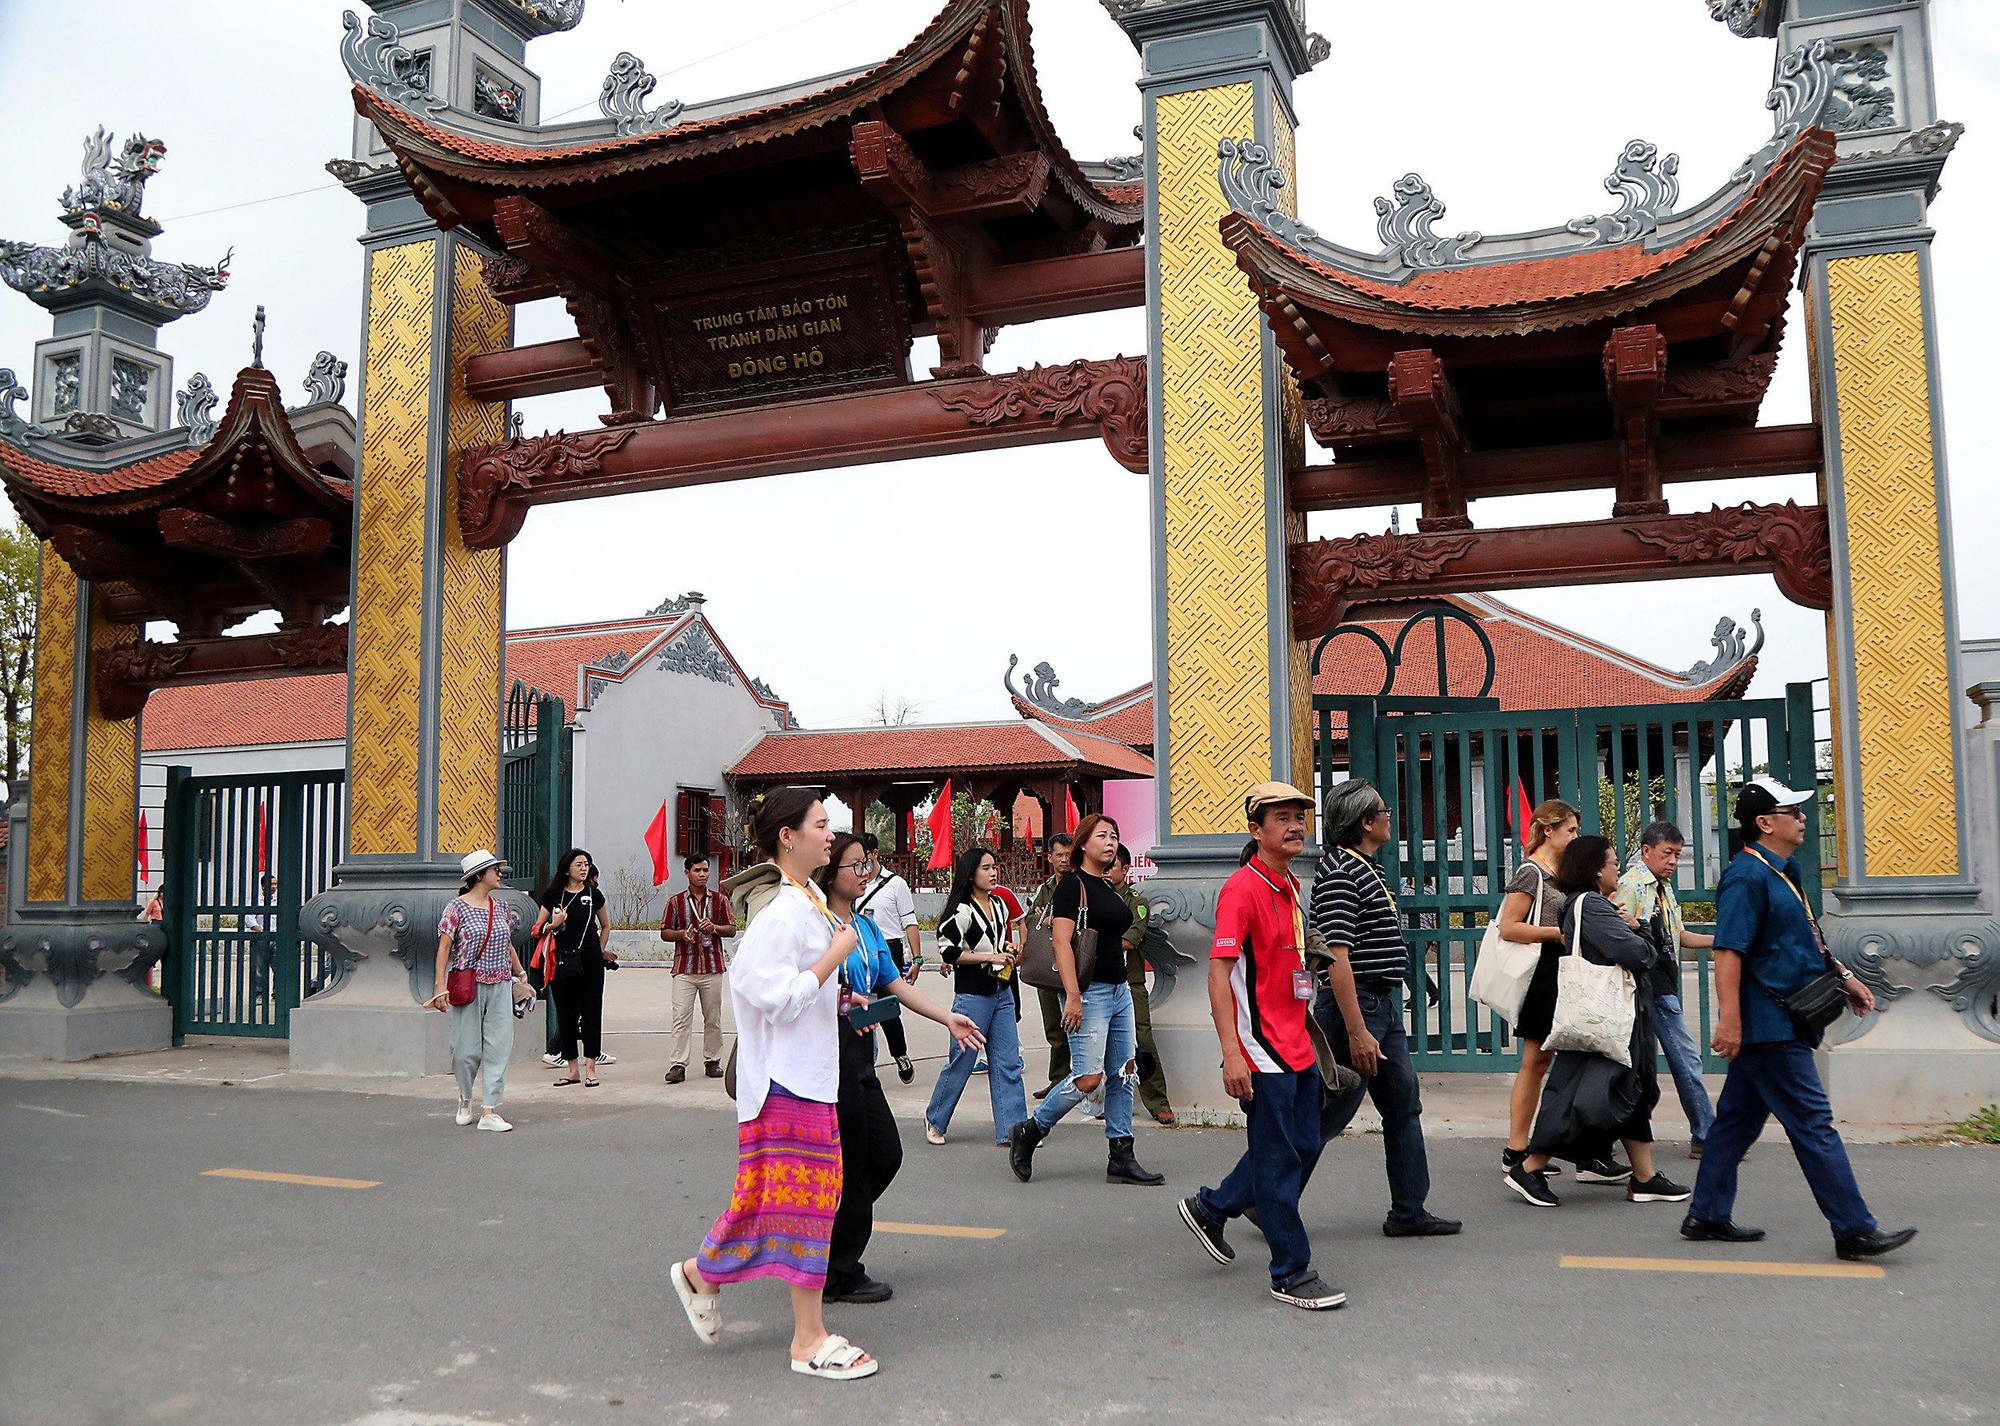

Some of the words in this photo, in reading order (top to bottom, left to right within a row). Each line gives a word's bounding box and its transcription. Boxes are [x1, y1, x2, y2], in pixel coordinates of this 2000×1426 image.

[694, 312, 743, 331] TRUNG
[746, 306, 778, 322] TÂM
[781, 298, 812, 317] BẢO
[707, 331, 762, 350] TRANH
[765, 324, 798, 342] DÂN
[802, 317, 842, 336] GIAN
[728, 356, 787, 378] ĐÔNG
[792, 345, 824, 369] HỒ
